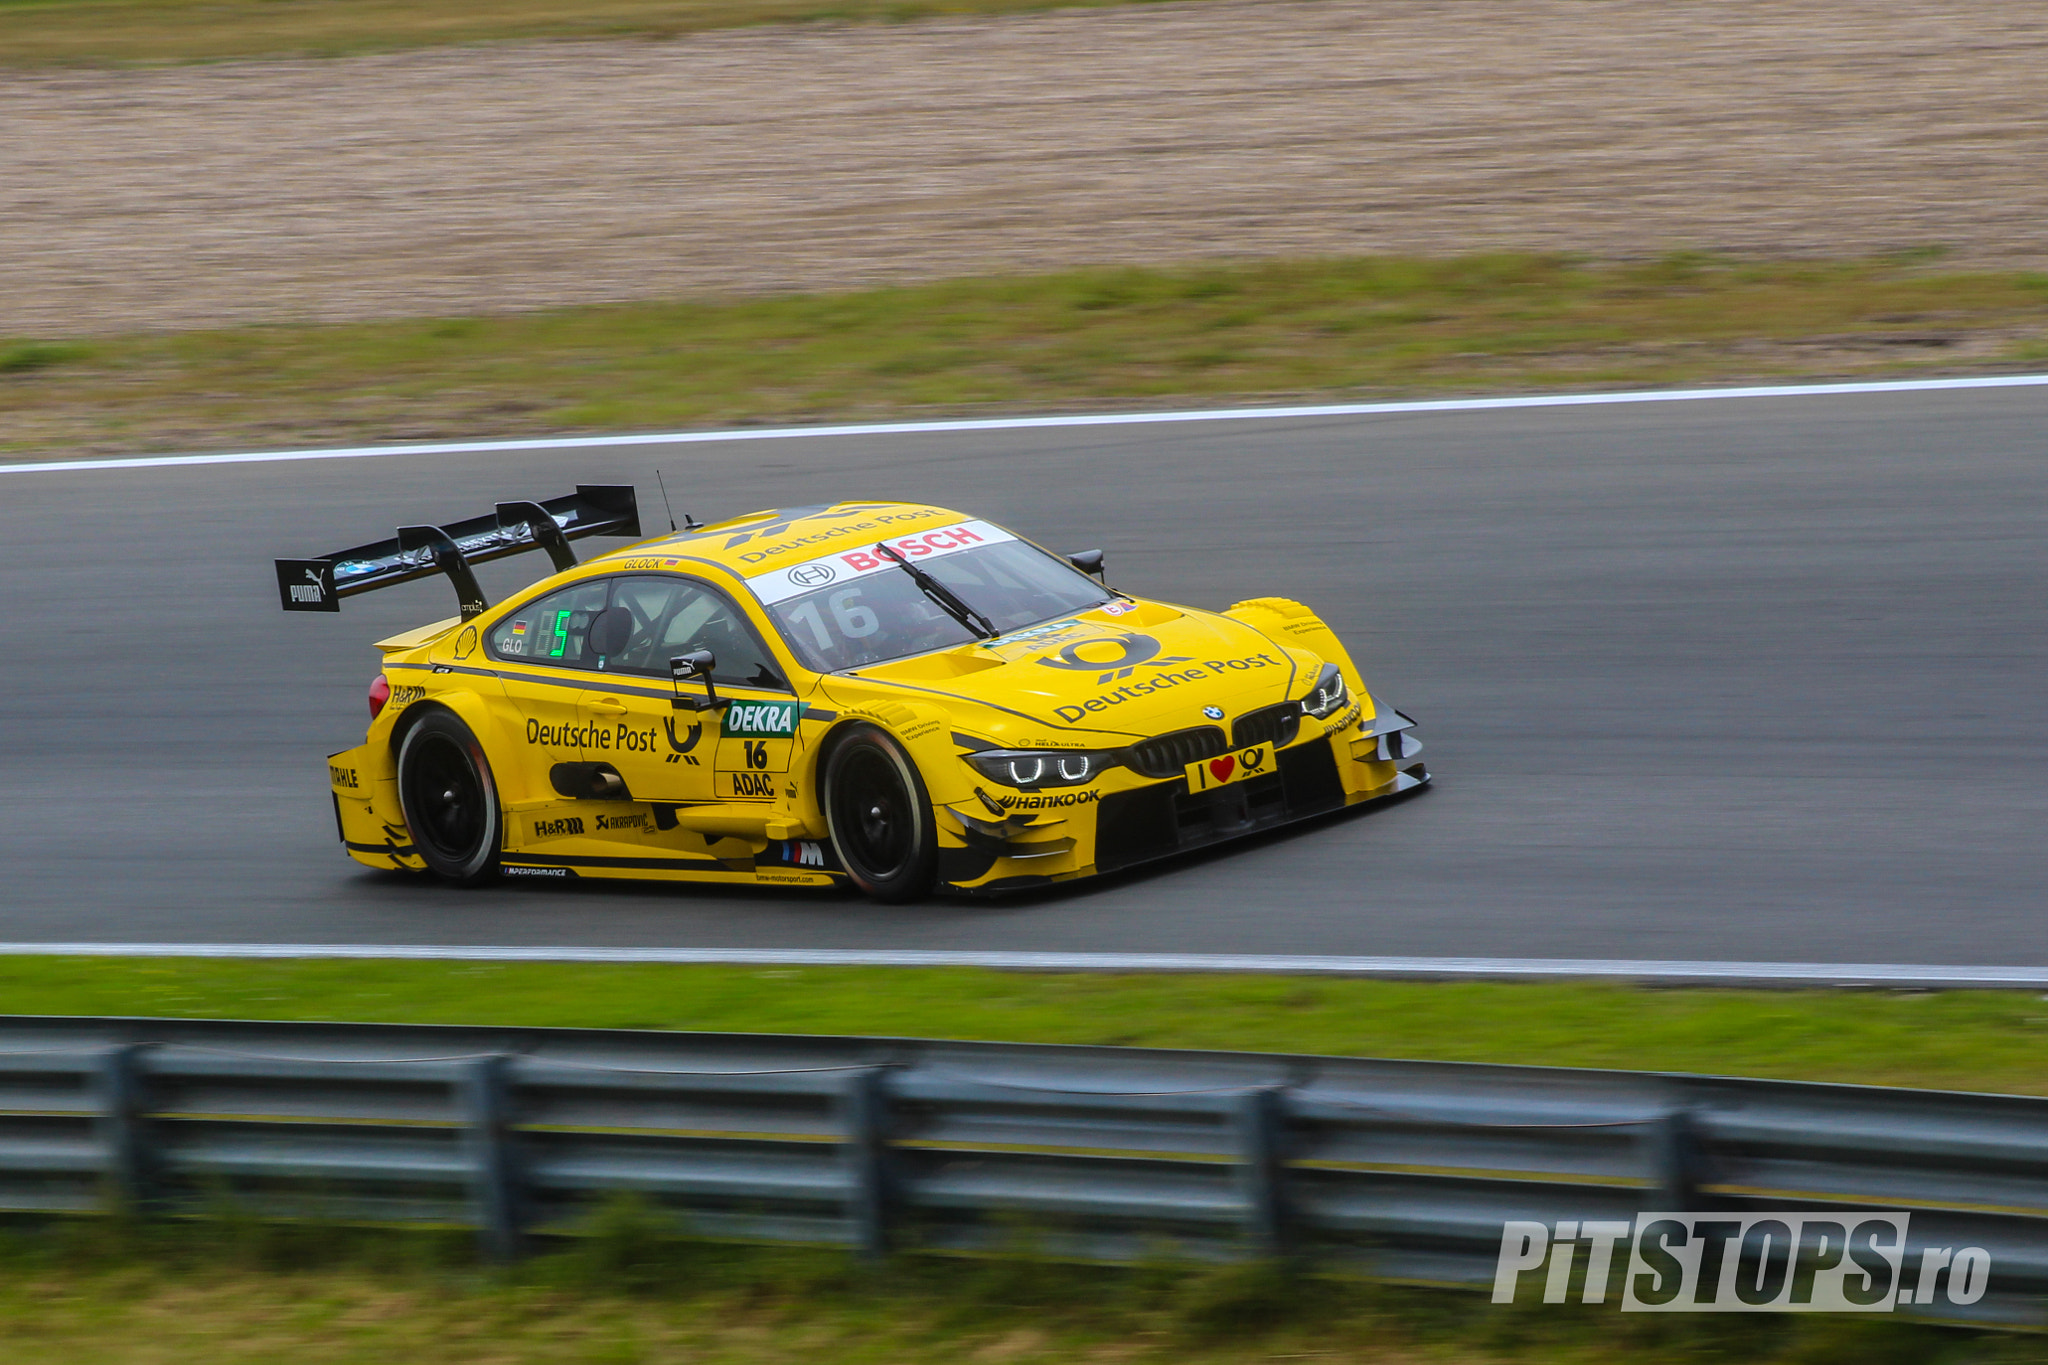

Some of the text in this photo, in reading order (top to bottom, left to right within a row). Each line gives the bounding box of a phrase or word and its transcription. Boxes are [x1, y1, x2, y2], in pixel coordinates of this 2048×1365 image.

[739, 508, 946, 563] Deutsche Post
[840, 527, 984, 572] BOSCH
[624, 558, 663, 569] GLOCK
[788, 587, 880, 650] 16
[502, 638, 522, 653] GLO
[549, 610, 571, 657] 5
[1053, 653, 1281, 723] Deutsche Post
[728, 705, 791, 732] DEKRA
[527, 718, 657, 752] Deutsche Post
[905, 726, 940, 741] Experience
[743, 740, 767, 770] 16
[329, 765, 359, 788] MAHLE
[732, 773, 775, 796] ADAC
[1198, 764, 1206, 789] I
[534, 819, 566, 836] H&R
